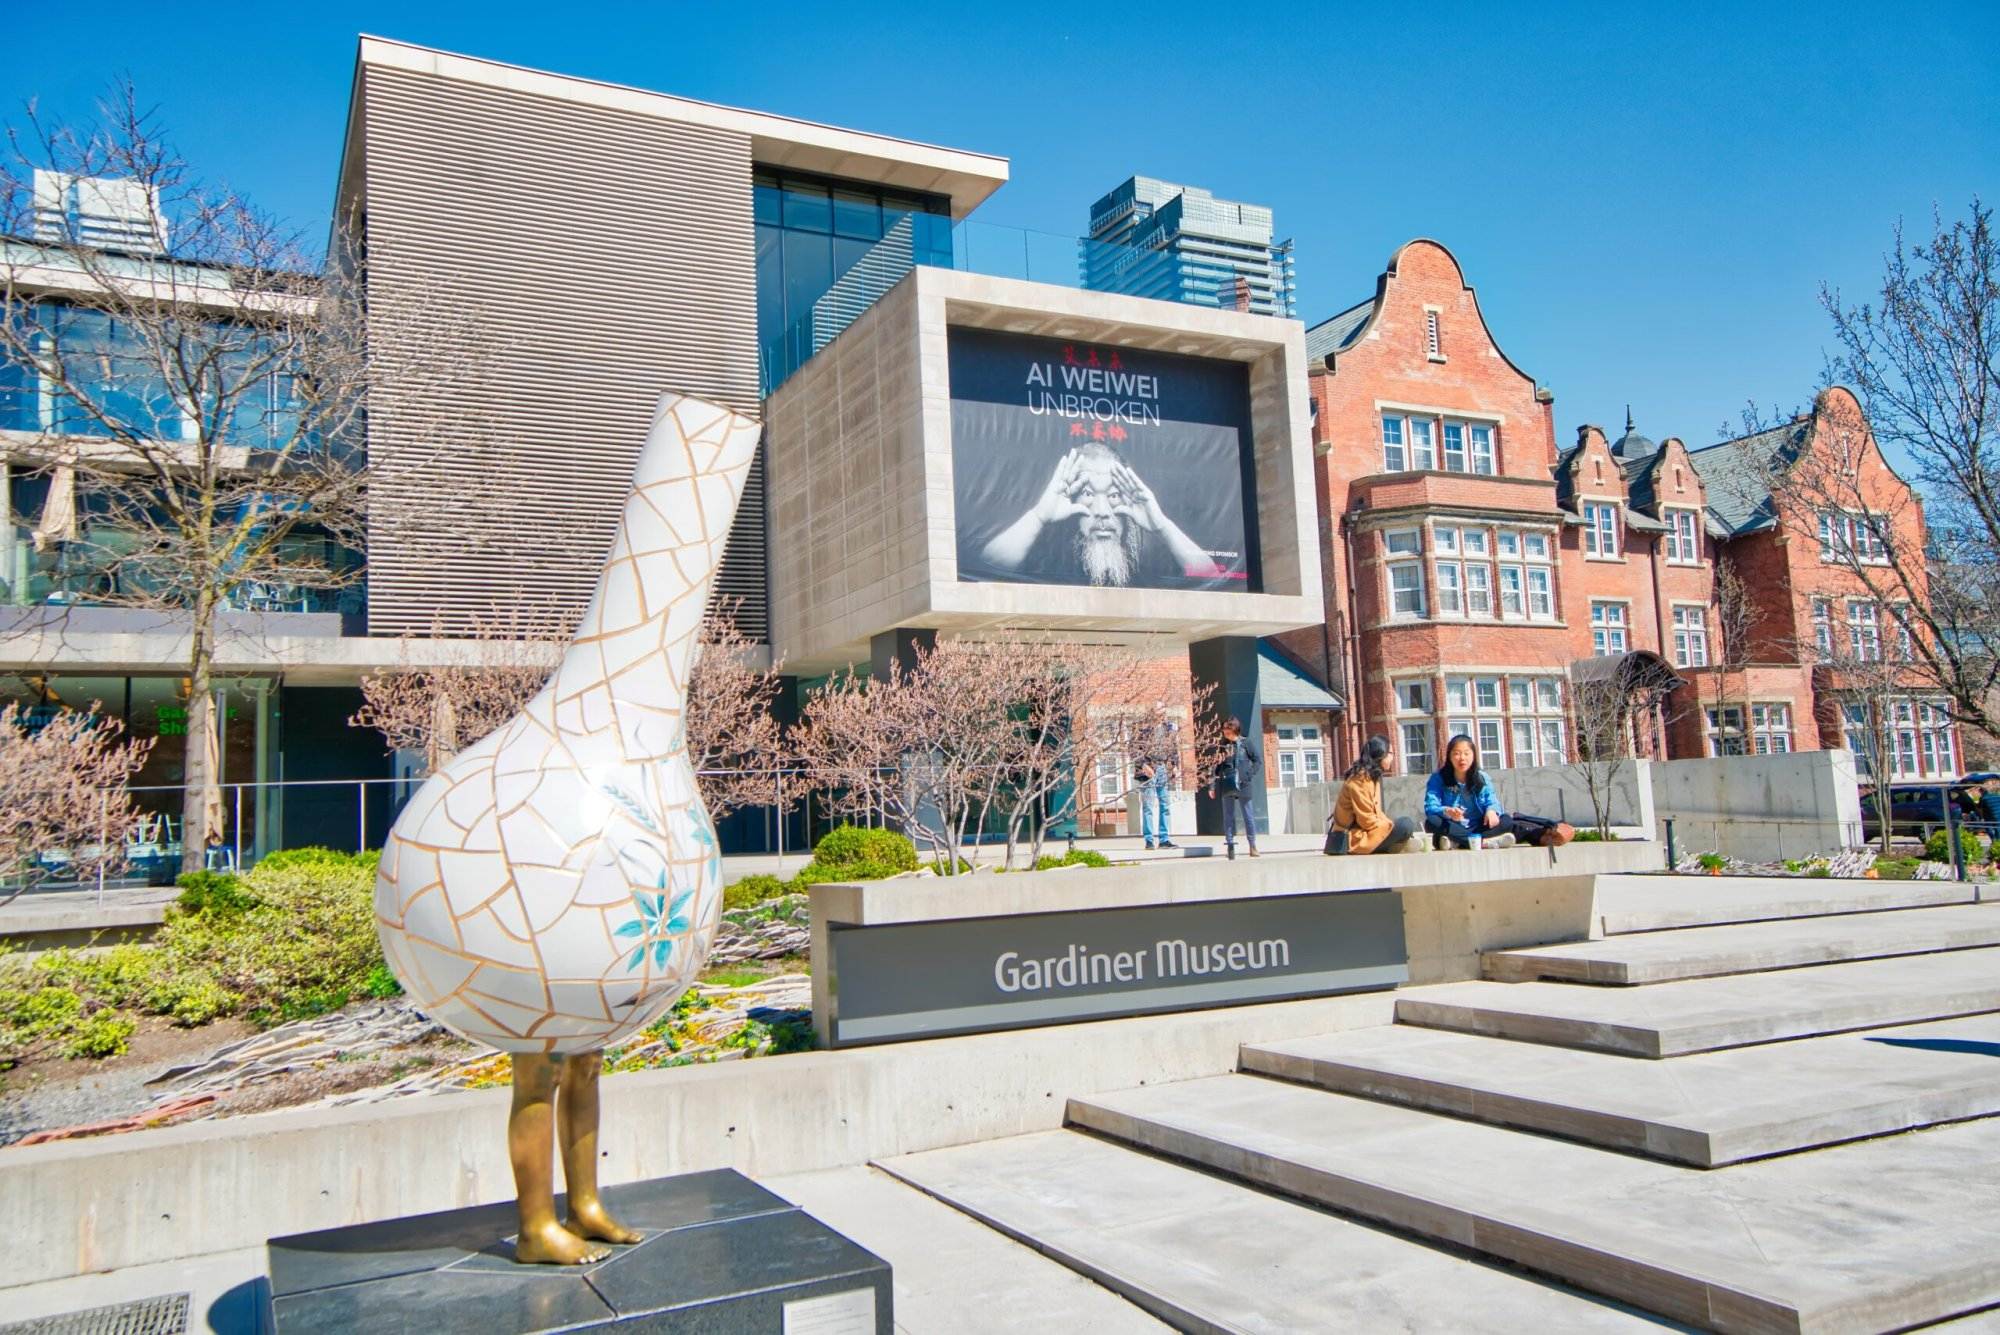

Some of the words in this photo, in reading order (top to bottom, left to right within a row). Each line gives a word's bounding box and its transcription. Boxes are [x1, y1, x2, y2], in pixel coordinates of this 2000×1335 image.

[1026, 361, 1053, 388] AI
[1061, 365, 1159, 399] WEIWEI
[1028, 390, 1161, 427] UNBROKEN
[994, 943, 1148, 993] Gardiner
[1155, 938, 1290, 978] Museum
